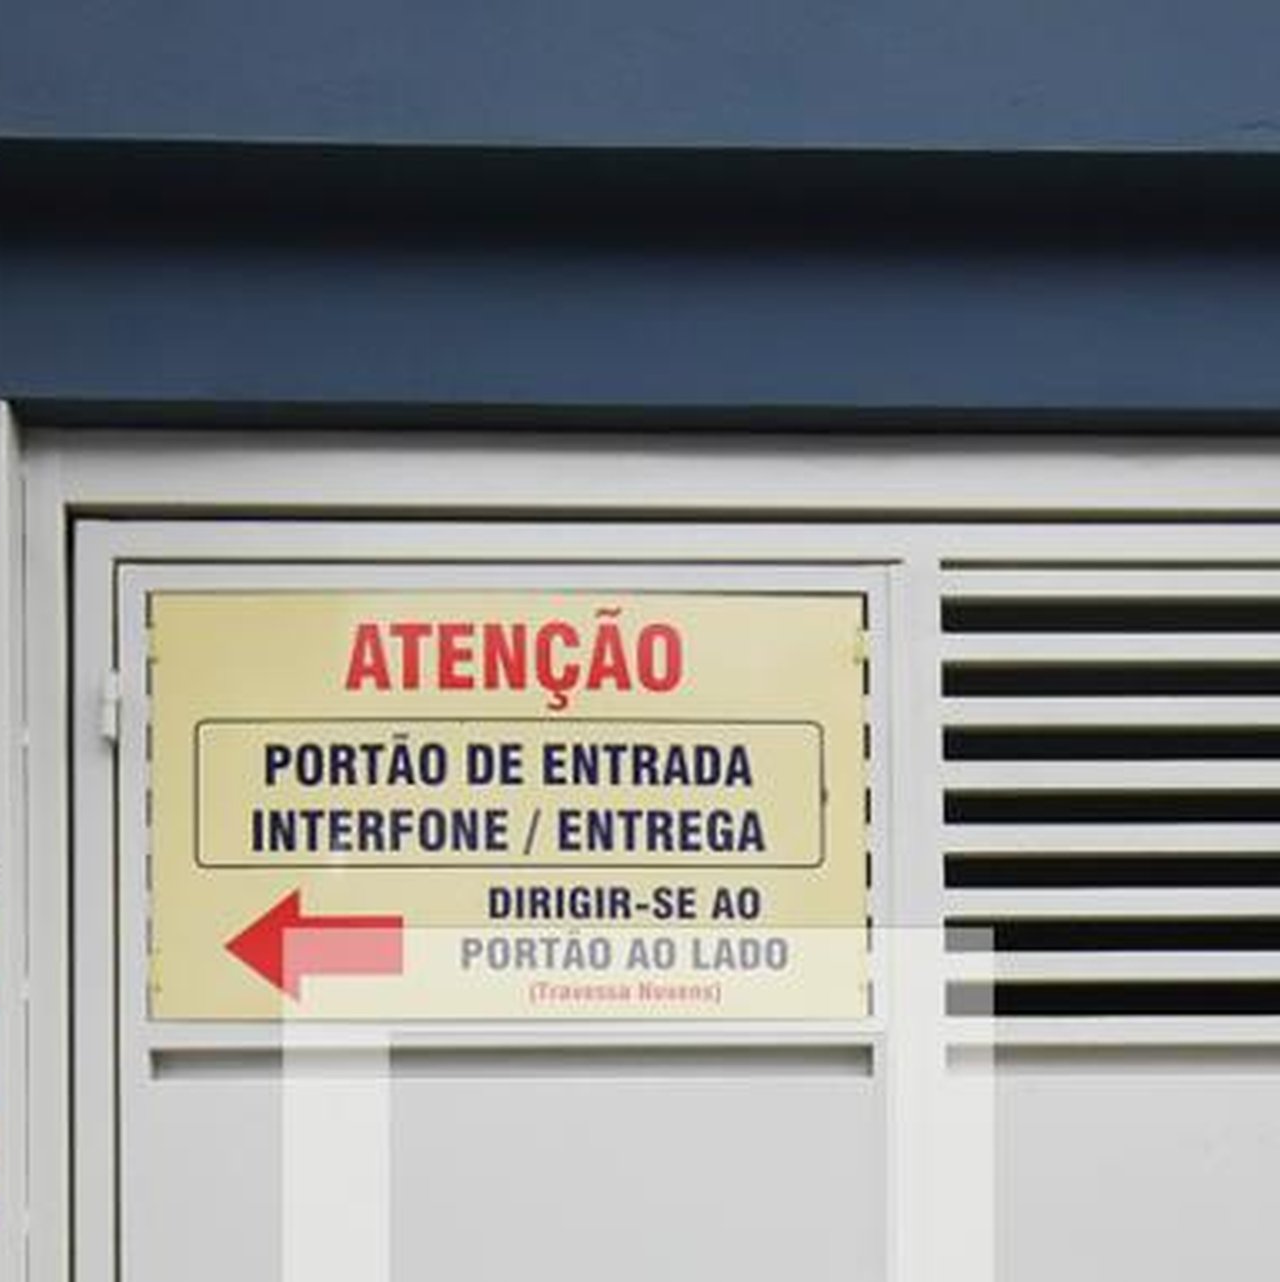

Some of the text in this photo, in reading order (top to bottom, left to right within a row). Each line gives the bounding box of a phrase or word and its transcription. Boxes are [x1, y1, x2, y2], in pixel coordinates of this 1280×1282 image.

[344, 606, 686, 712] ATENÇÃO
[264, 733, 753, 788] PORTÃO DE ENTRADA
[251, 808, 509, 853] INTERFONE
[557, 808, 766, 853] ENTREGA
[488, 886, 762, 920] DIRIGIR-SE AO
[460, 928, 790, 971] PORTÃO AO LADO
